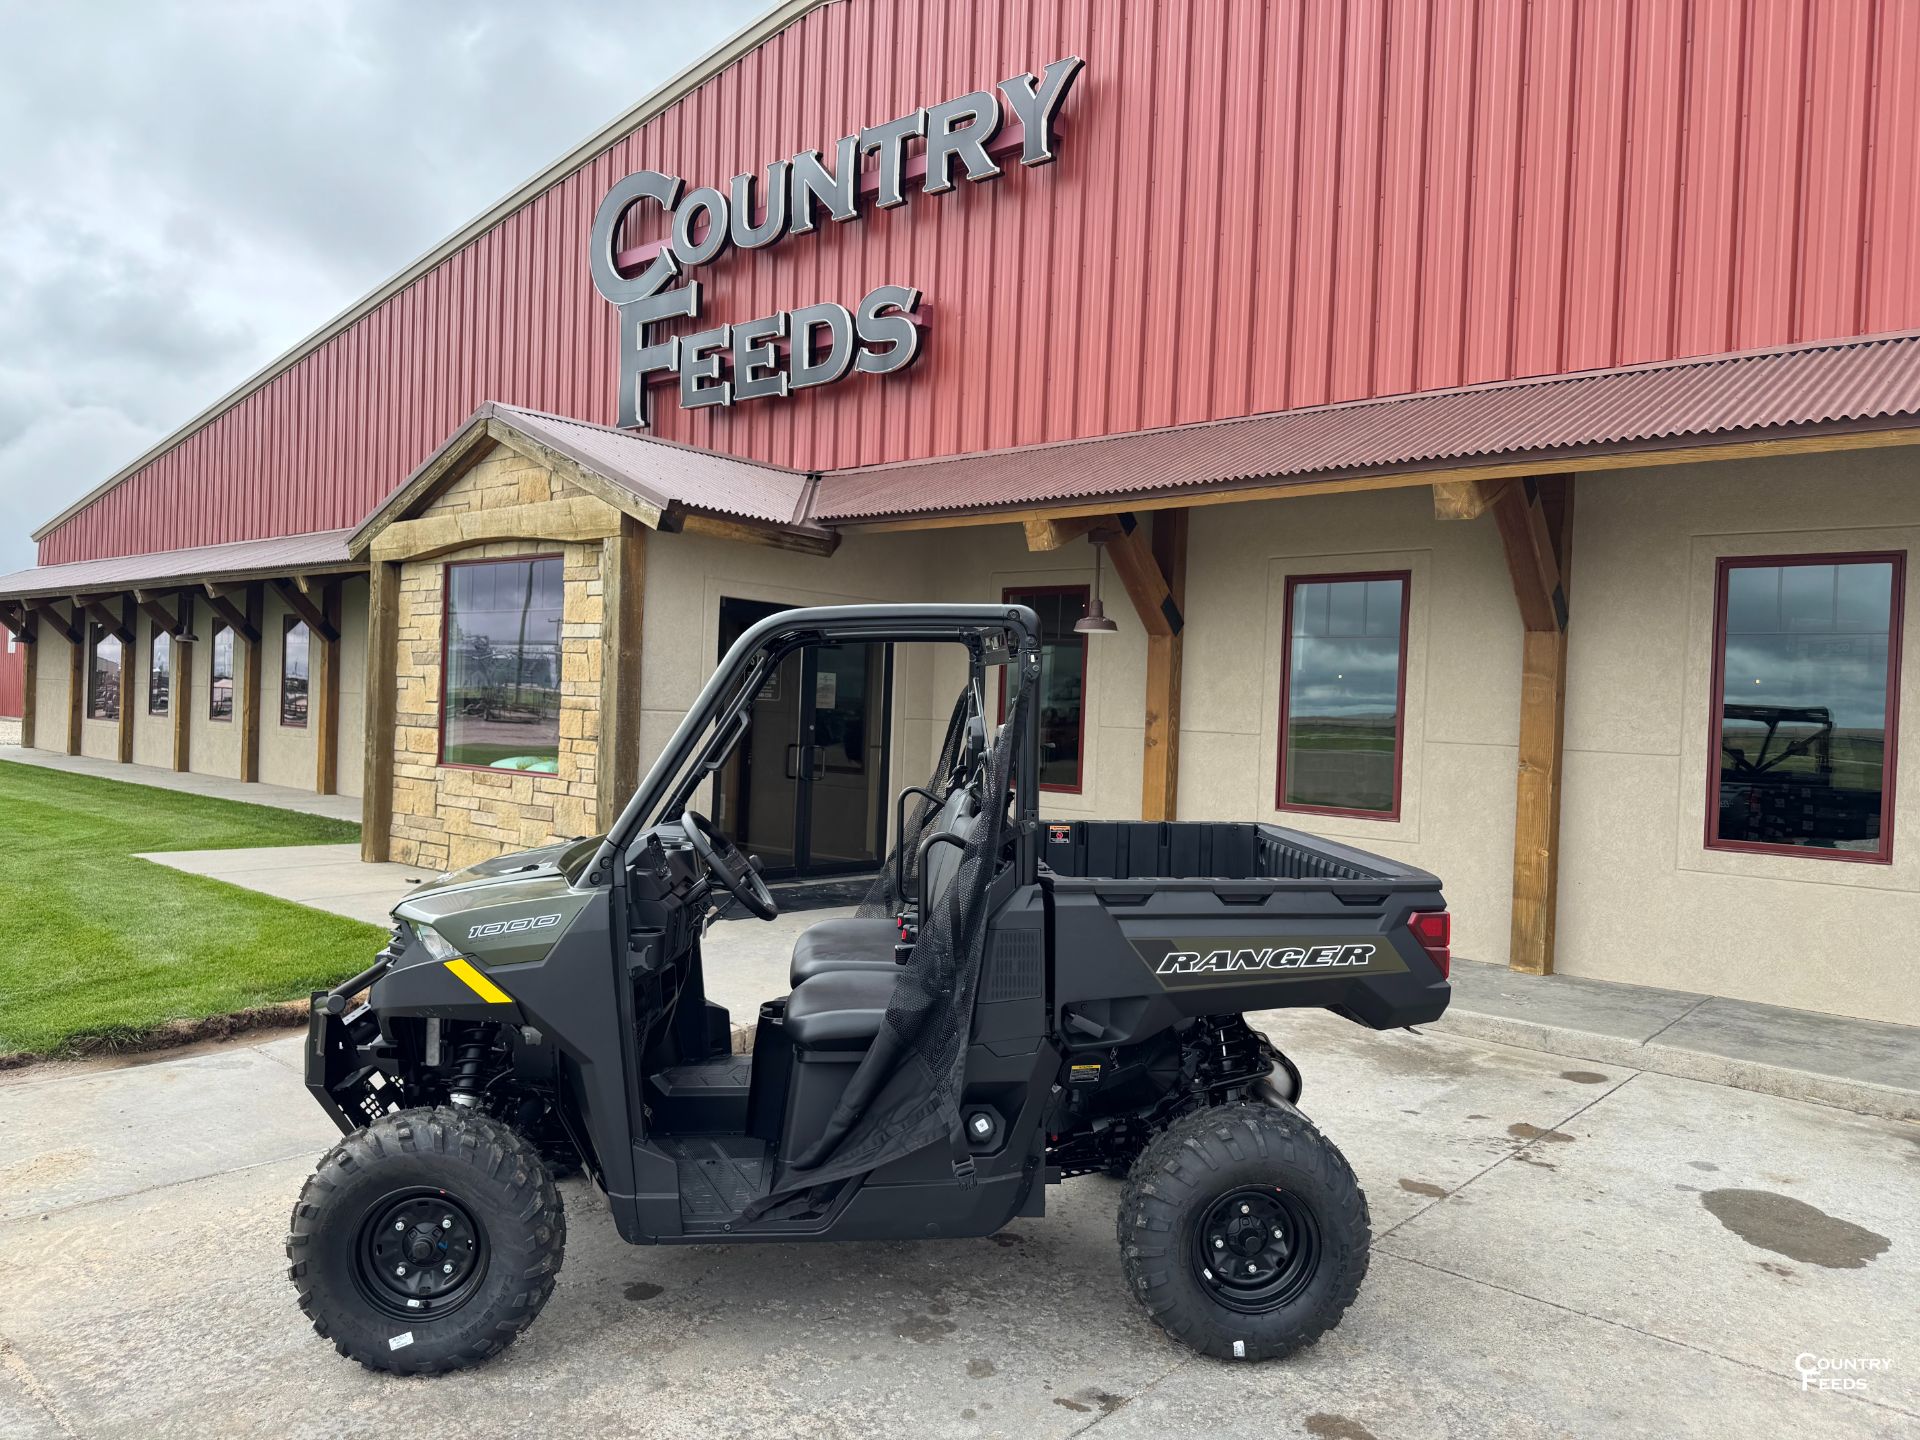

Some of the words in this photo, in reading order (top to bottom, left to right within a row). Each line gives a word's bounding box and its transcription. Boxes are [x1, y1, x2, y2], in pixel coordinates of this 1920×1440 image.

[589, 55, 1085, 306] COUNTRY
[616, 280, 923, 430] FEEDS
[467, 913, 562, 939] 1000
[1155, 943, 1377, 974] RANGER
